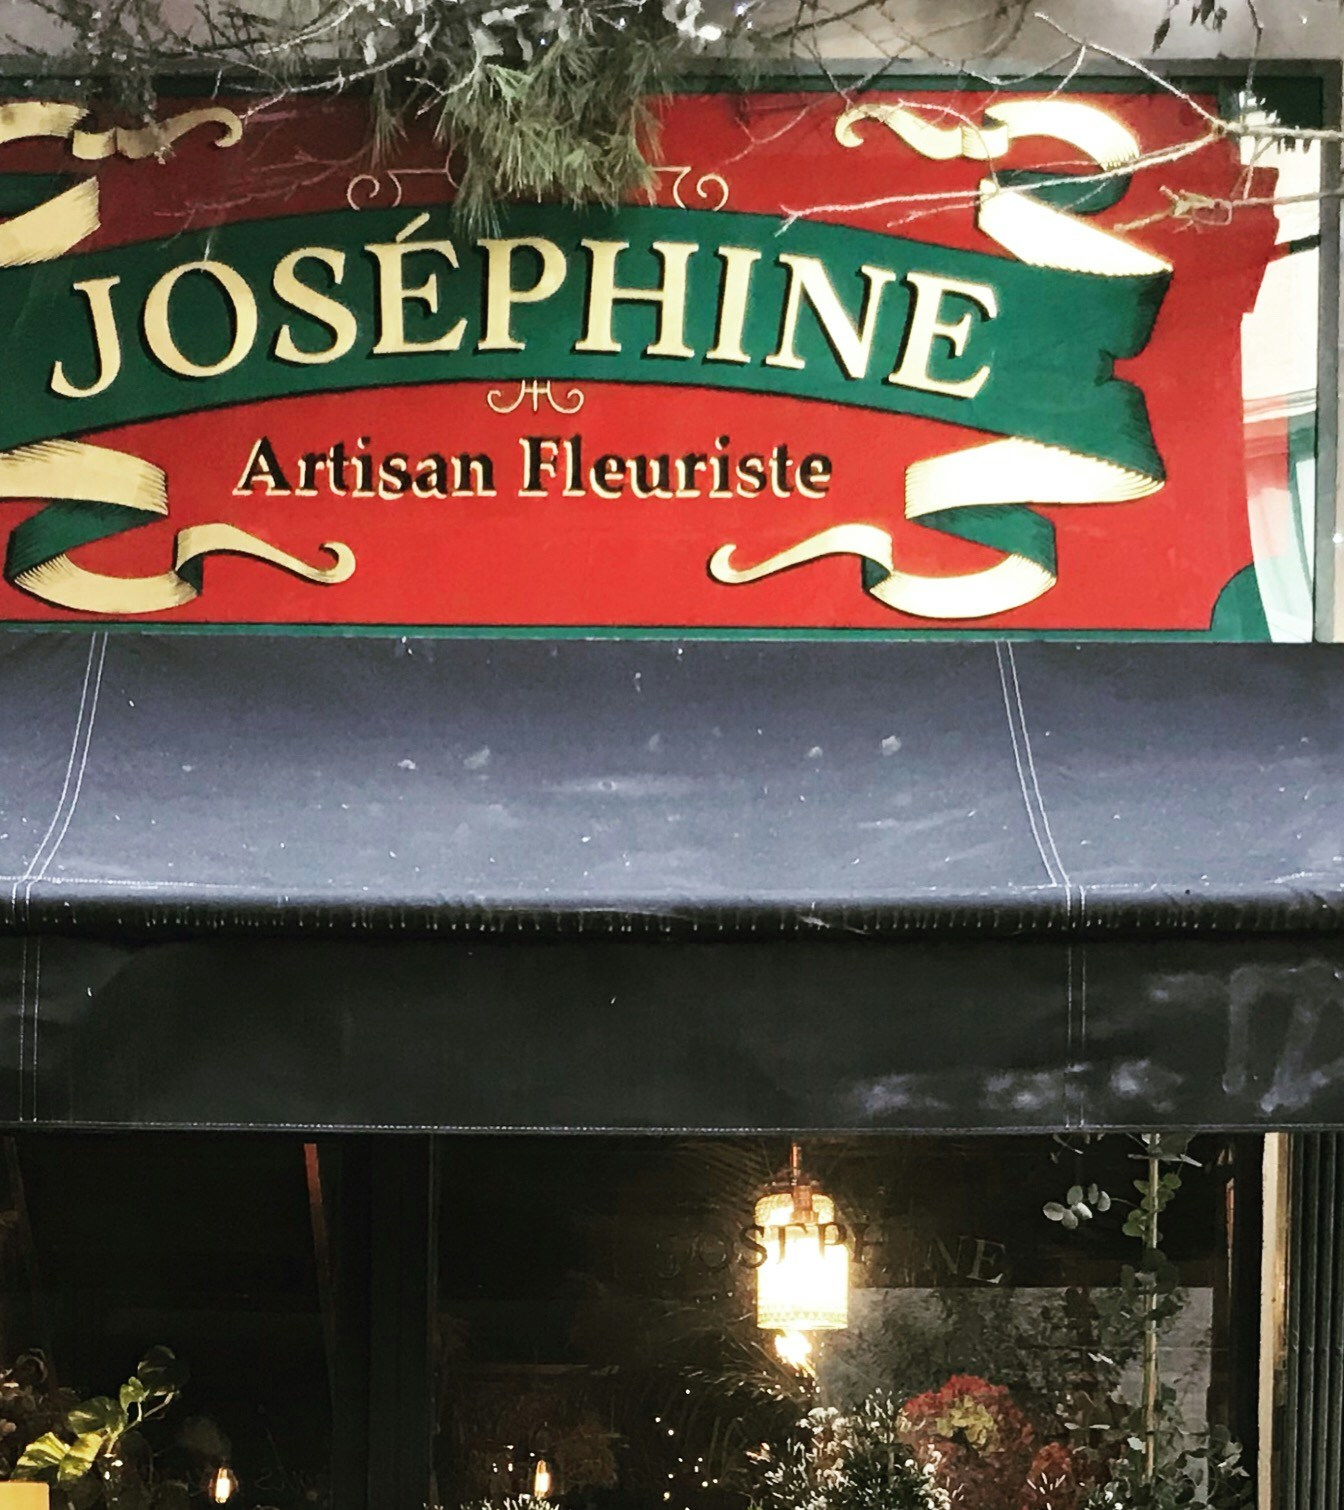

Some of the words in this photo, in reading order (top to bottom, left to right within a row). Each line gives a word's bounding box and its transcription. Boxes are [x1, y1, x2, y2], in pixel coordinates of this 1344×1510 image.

[49, 212, 999, 400] JOSÉPHINE
[232, 435, 497, 501] Artisan
[518, 435, 833, 500] Fleuriste
